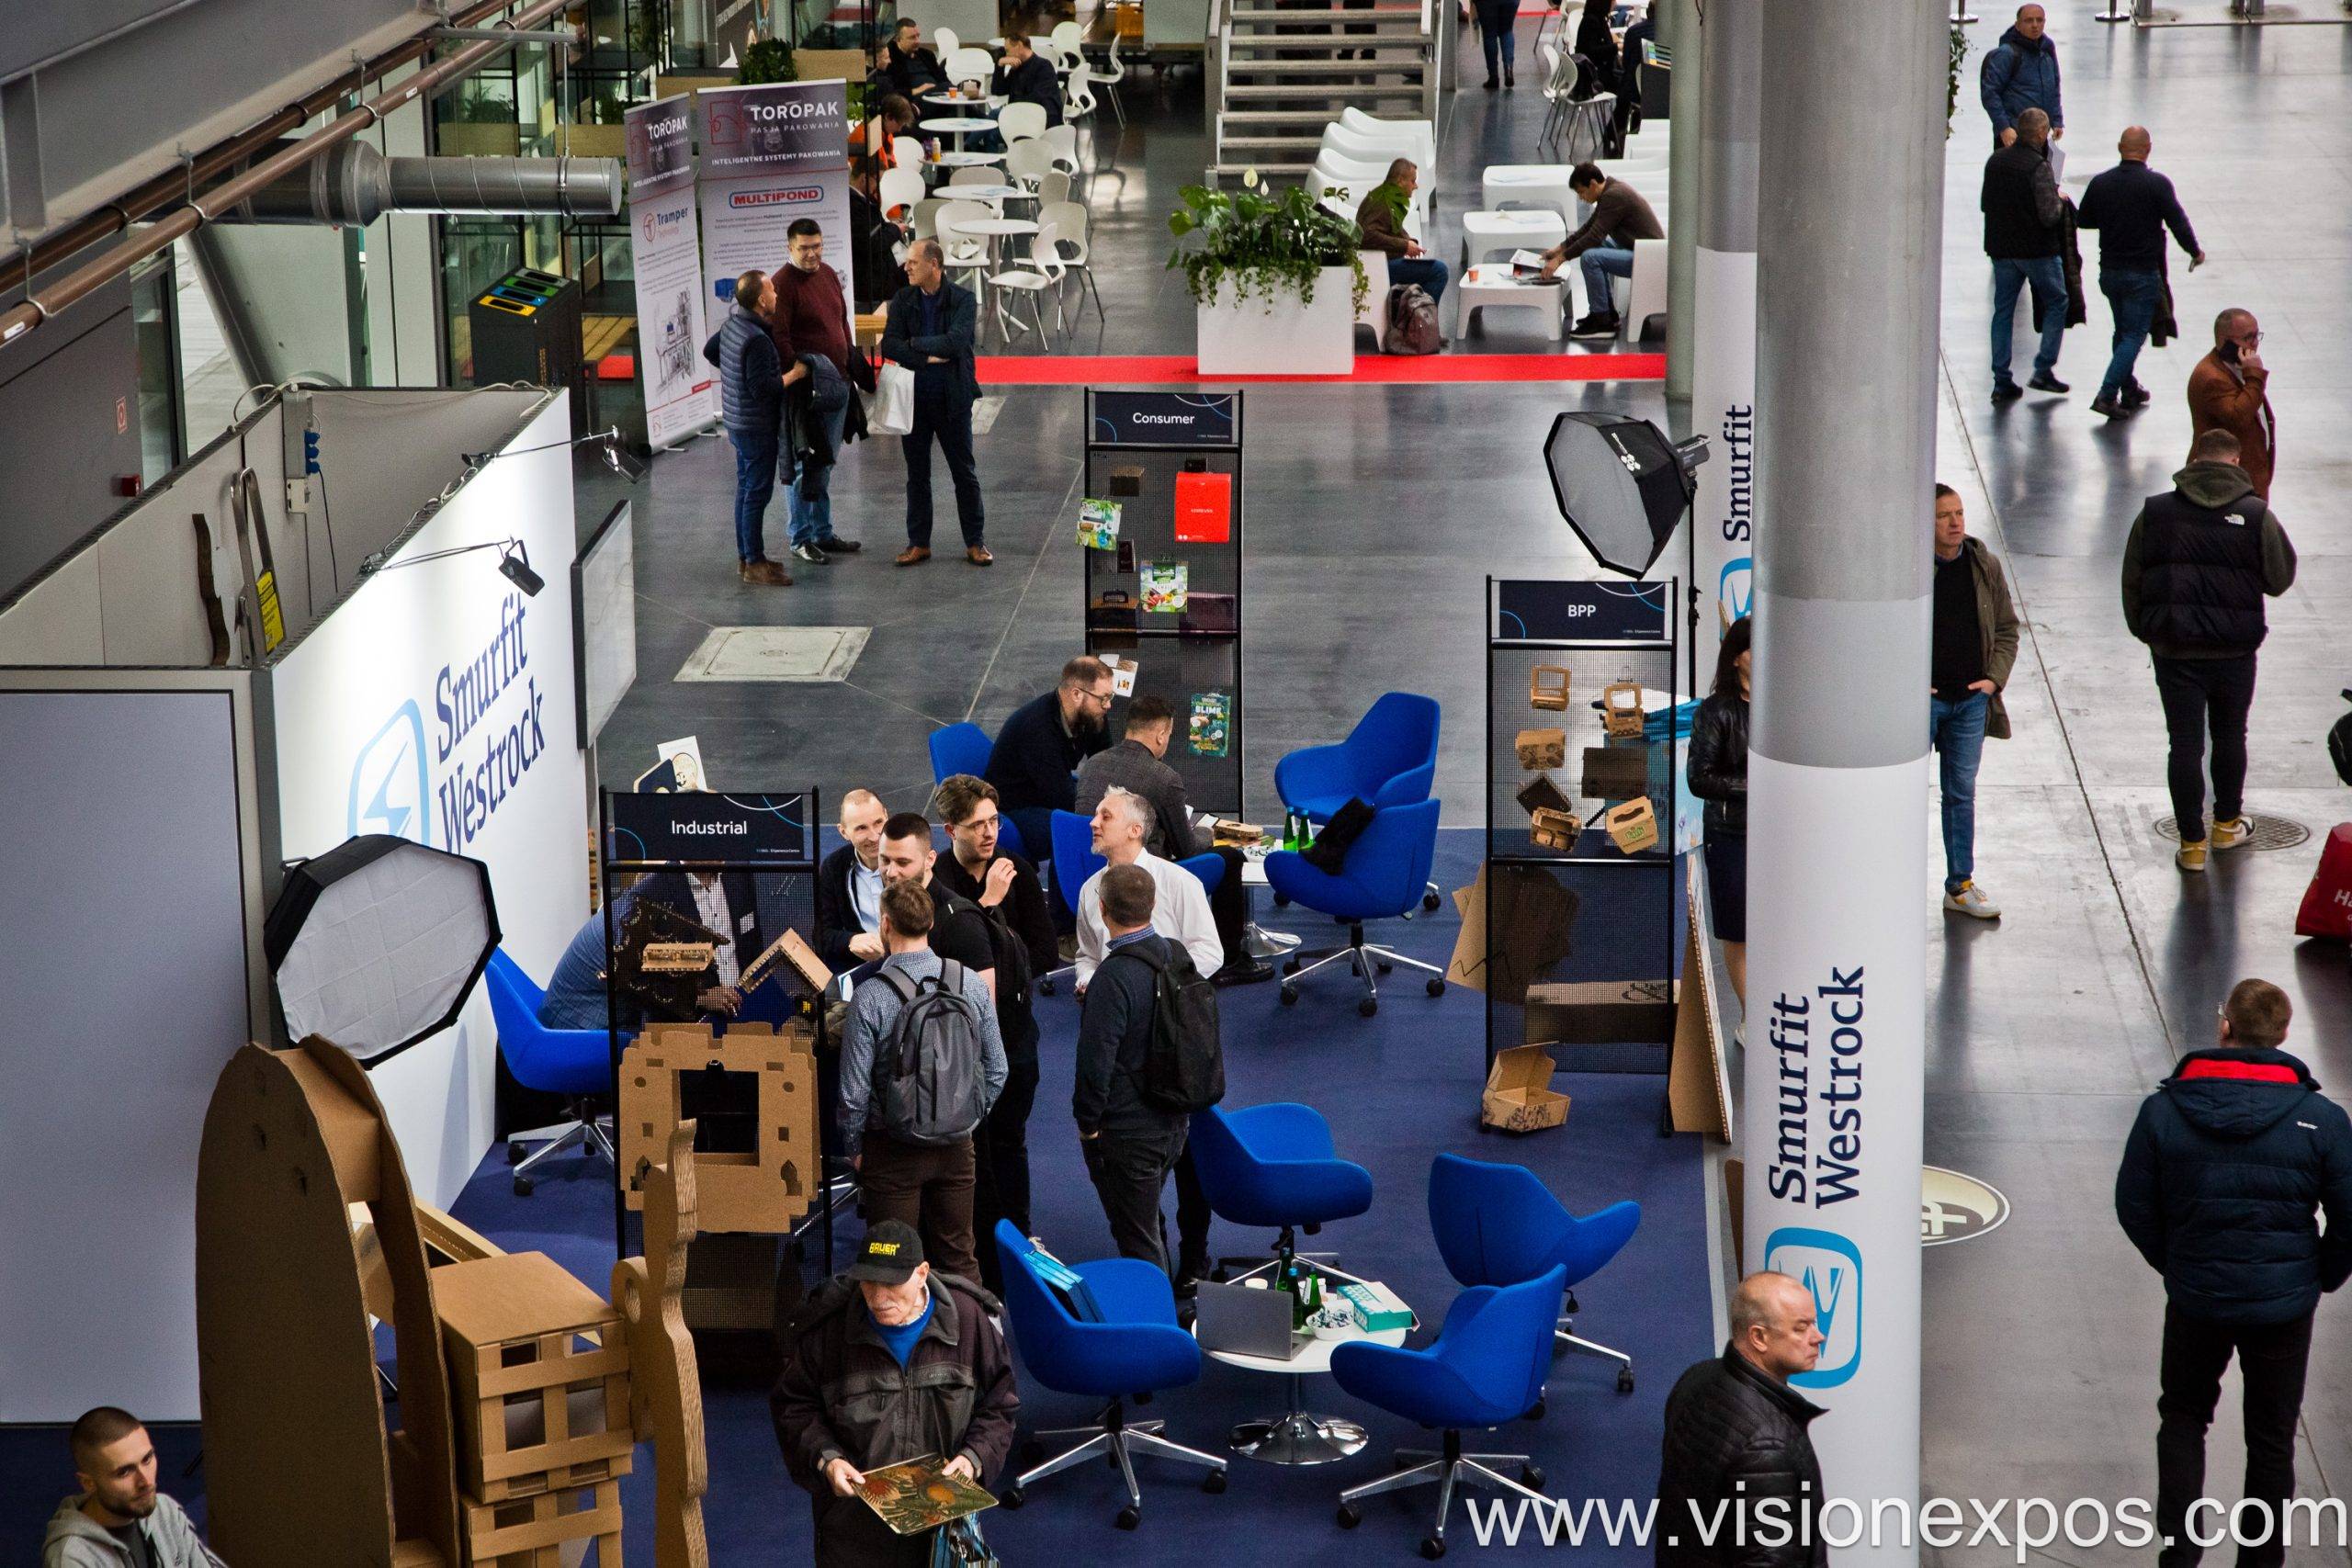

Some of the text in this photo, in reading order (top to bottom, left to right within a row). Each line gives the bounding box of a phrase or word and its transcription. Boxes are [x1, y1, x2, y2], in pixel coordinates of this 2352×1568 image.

[750, 101, 839, 121] TOROPAK
[648, 116, 688, 140] TOROPAK
[750, 121, 840, 134] PASJA PAKOWANIA
[711, 150, 841, 166] INTELIGENTNE SYSTEMY PAKOWANIA
[734, 189, 819, 205] MULTIPOND
[657, 207, 688, 226] Tramper
[1132, 412, 1195, 424] Consumer
[1723, 404, 1752, 541] Smurfit
[1567, 604, 1597, 617] BPP
[435, 591, 528, 765] Smurfit
[439, 675, 546, 855] Westrock
[672, 819, 748, 835] Industrial
[1815, 965, 1864, 1210] Westrock
[1769, 992, 1810, 1204] Smurfit
